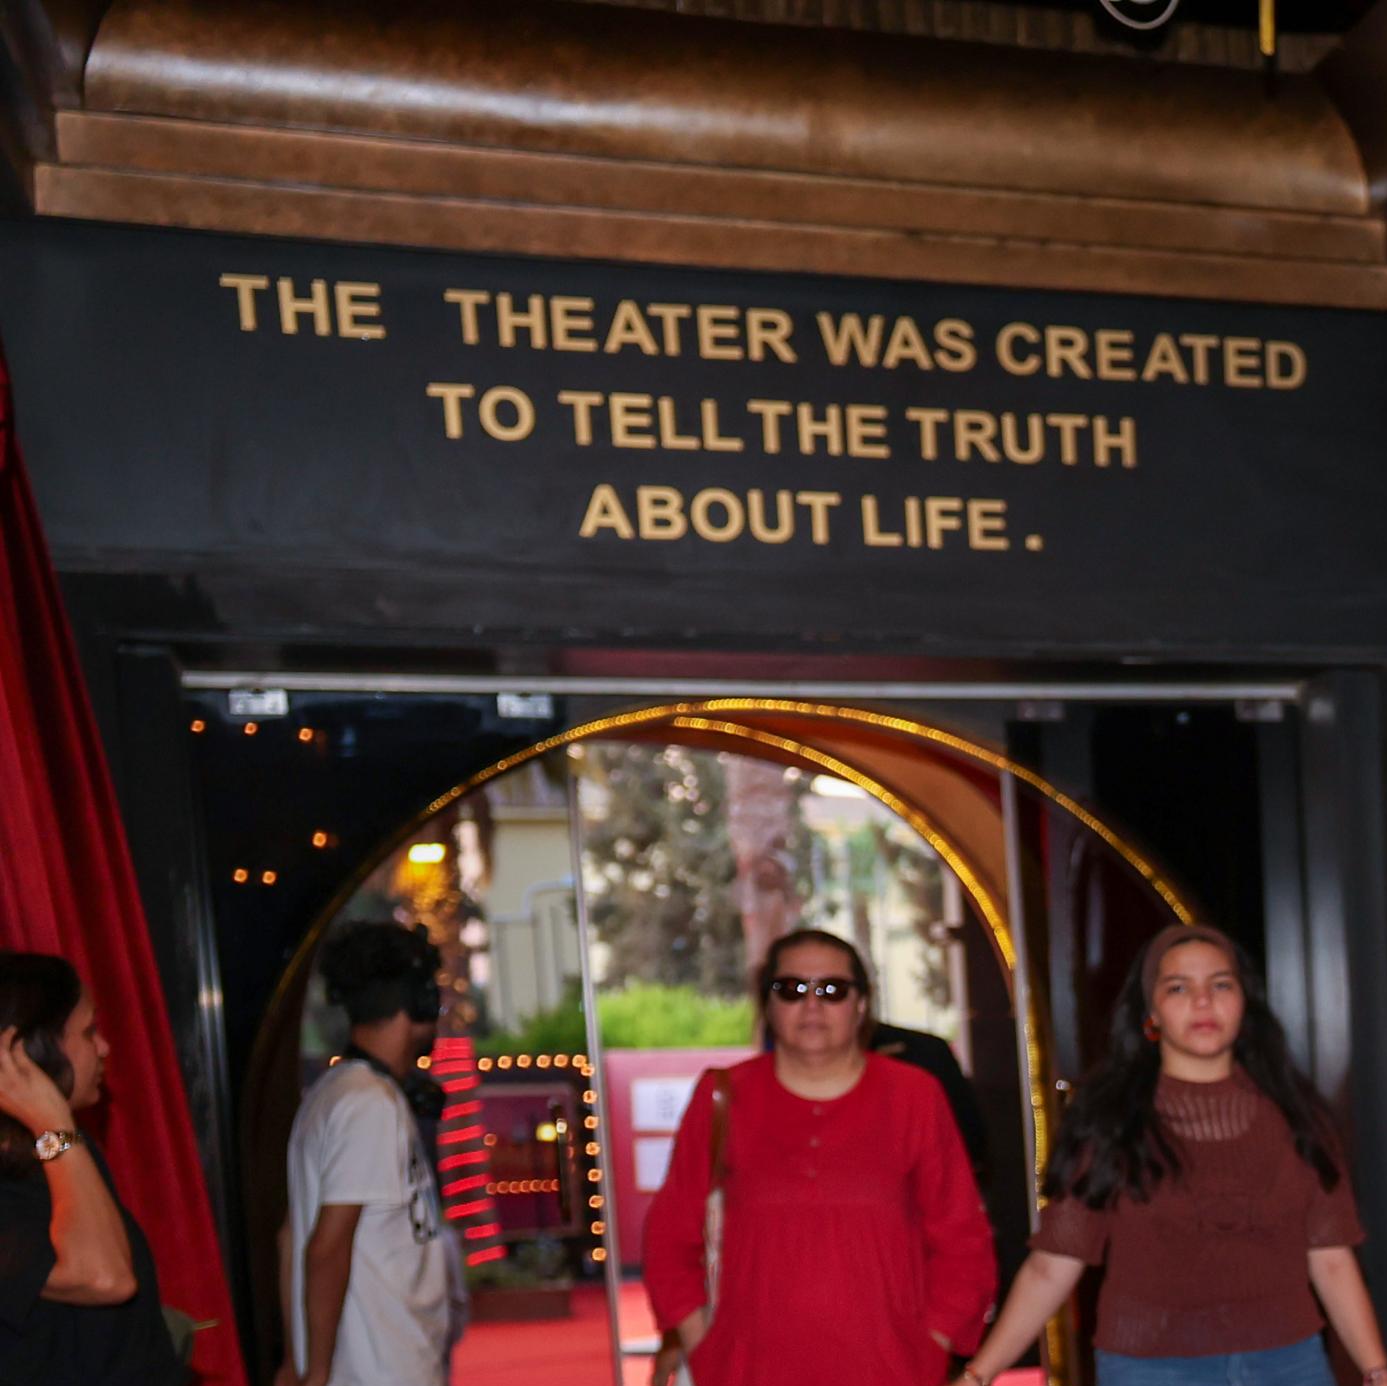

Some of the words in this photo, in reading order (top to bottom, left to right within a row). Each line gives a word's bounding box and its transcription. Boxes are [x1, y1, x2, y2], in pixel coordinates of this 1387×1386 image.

[221, 275, 388, 339] THE
[444, 289, 797, 363] THEATER
[817, 313, 976, 372] WAS
[996, 323, 1308, 390] CREATED
[426, 383, 537, 442] TO
[559, 391, 744, 452] TELL
[747, 400, 888, 458] THE
[906, 408, 1137, 468] TRUTH
[580, 484, 843, 544] ABOUT
